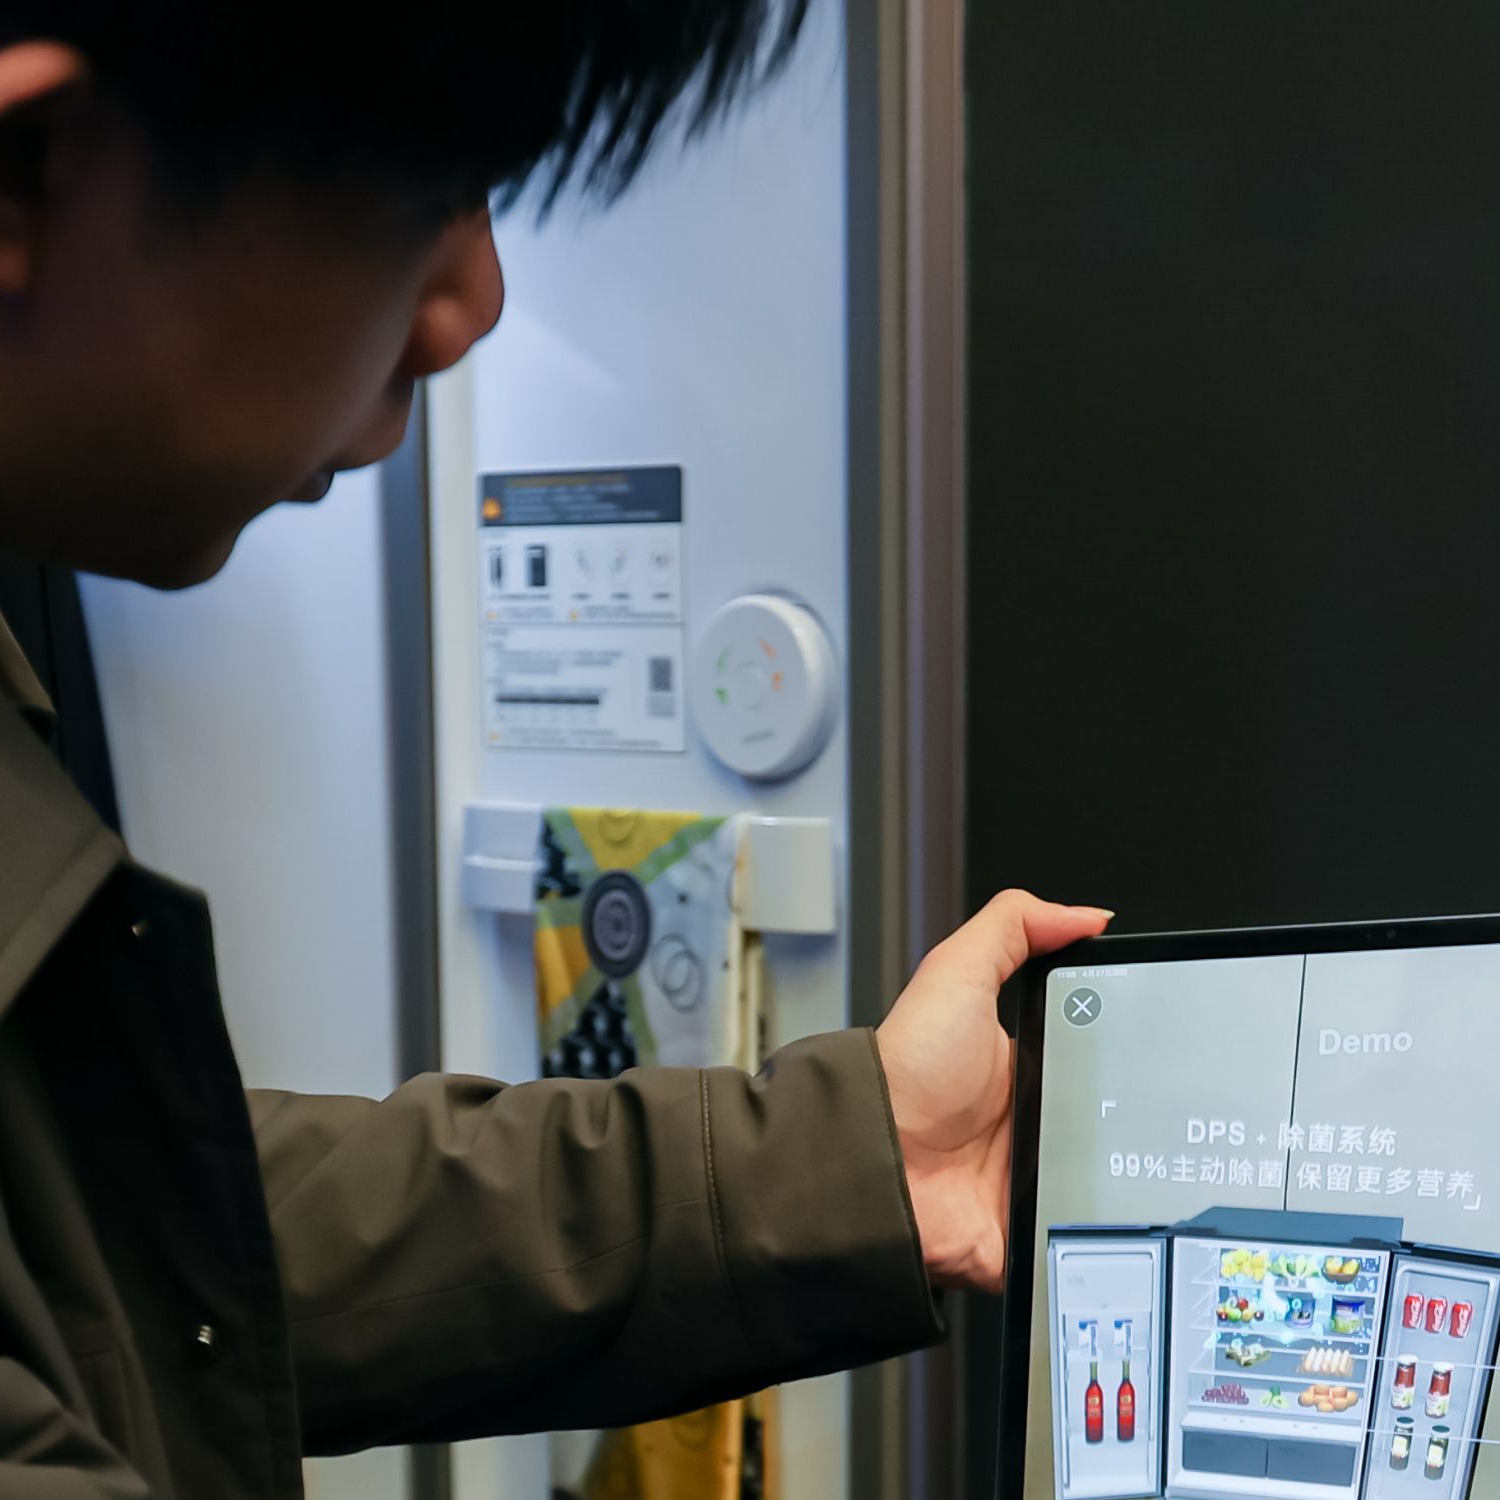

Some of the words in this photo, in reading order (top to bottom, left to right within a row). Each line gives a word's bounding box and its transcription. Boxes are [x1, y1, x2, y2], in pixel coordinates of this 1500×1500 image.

[1318, 1028, 1413, 1056] Demo
[1186, 1118, 1246, 1145] DPS
[1277, 1122, 1398, 1157] 除菌系统
[1109, 1152, 1284, 1189] 99%主动除菌
[1296, 1161, 1475, 1200] 保留更多营养
